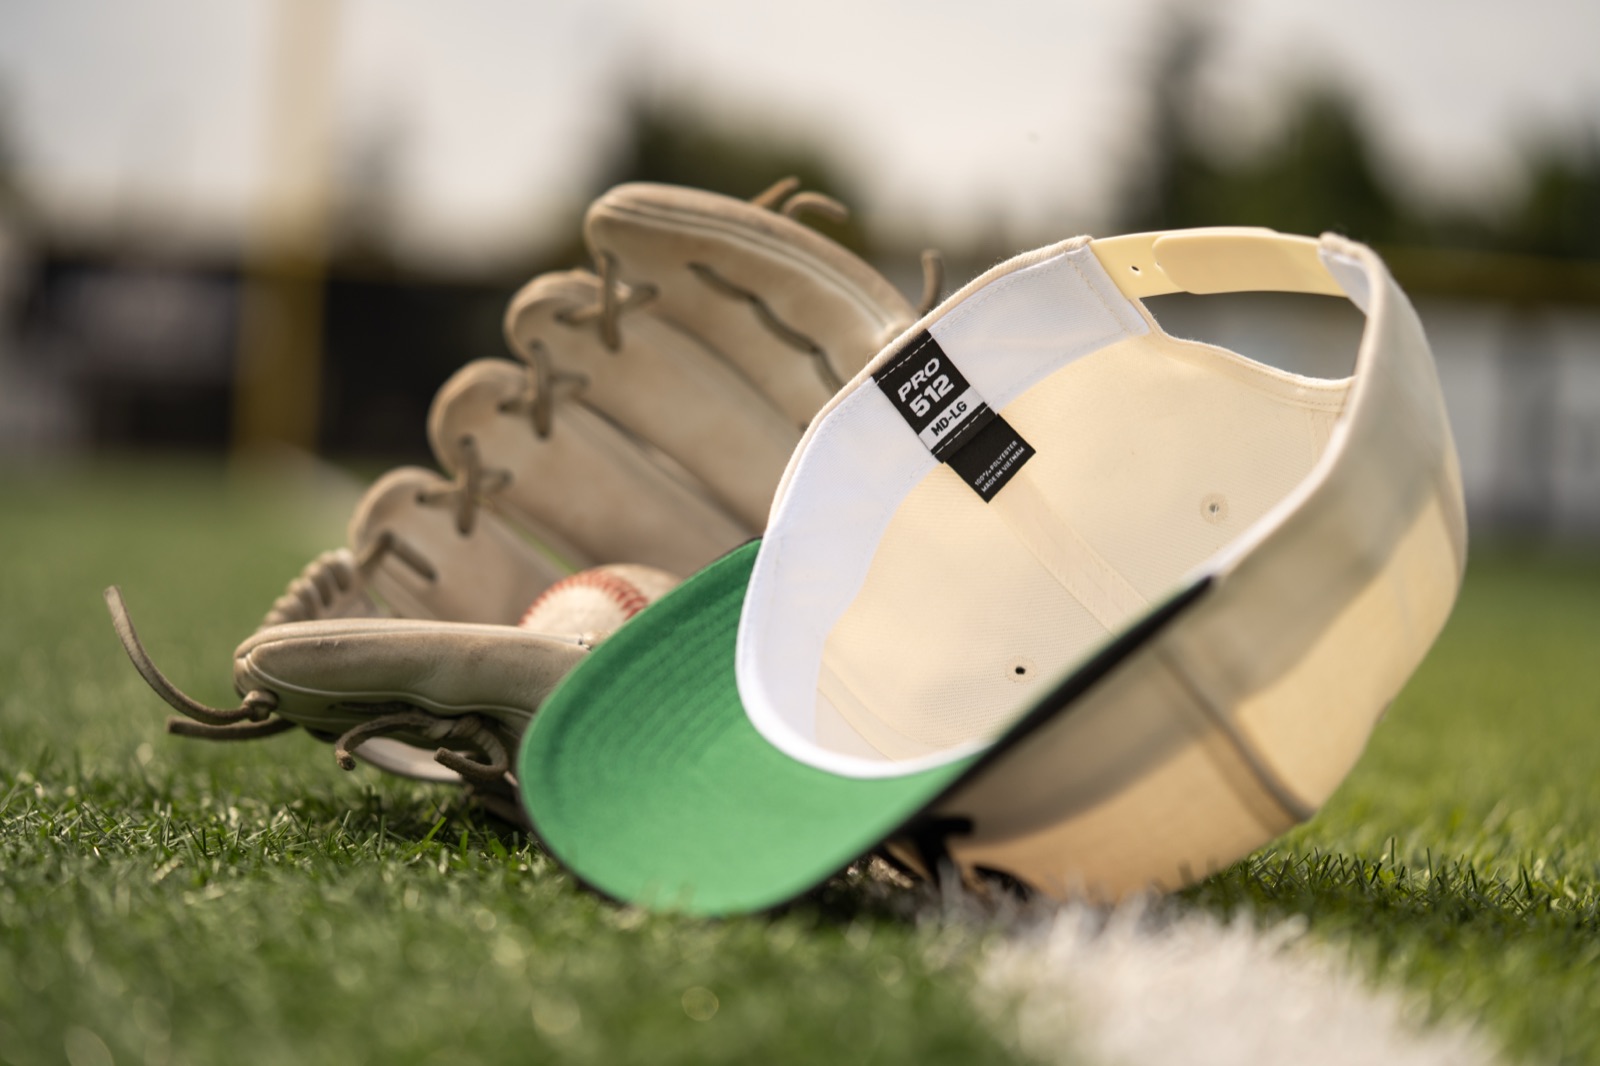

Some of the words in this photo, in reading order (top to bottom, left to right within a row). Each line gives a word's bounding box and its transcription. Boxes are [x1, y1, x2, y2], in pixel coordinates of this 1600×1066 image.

[897, 357, 941, 403] PRO
[909, 374, 955, 417] 512
[930, 401, 968, 437] MD-LG
[980, 476, 997, 493] MADE
[1001, 446, 1025, 471] VIETNAM
